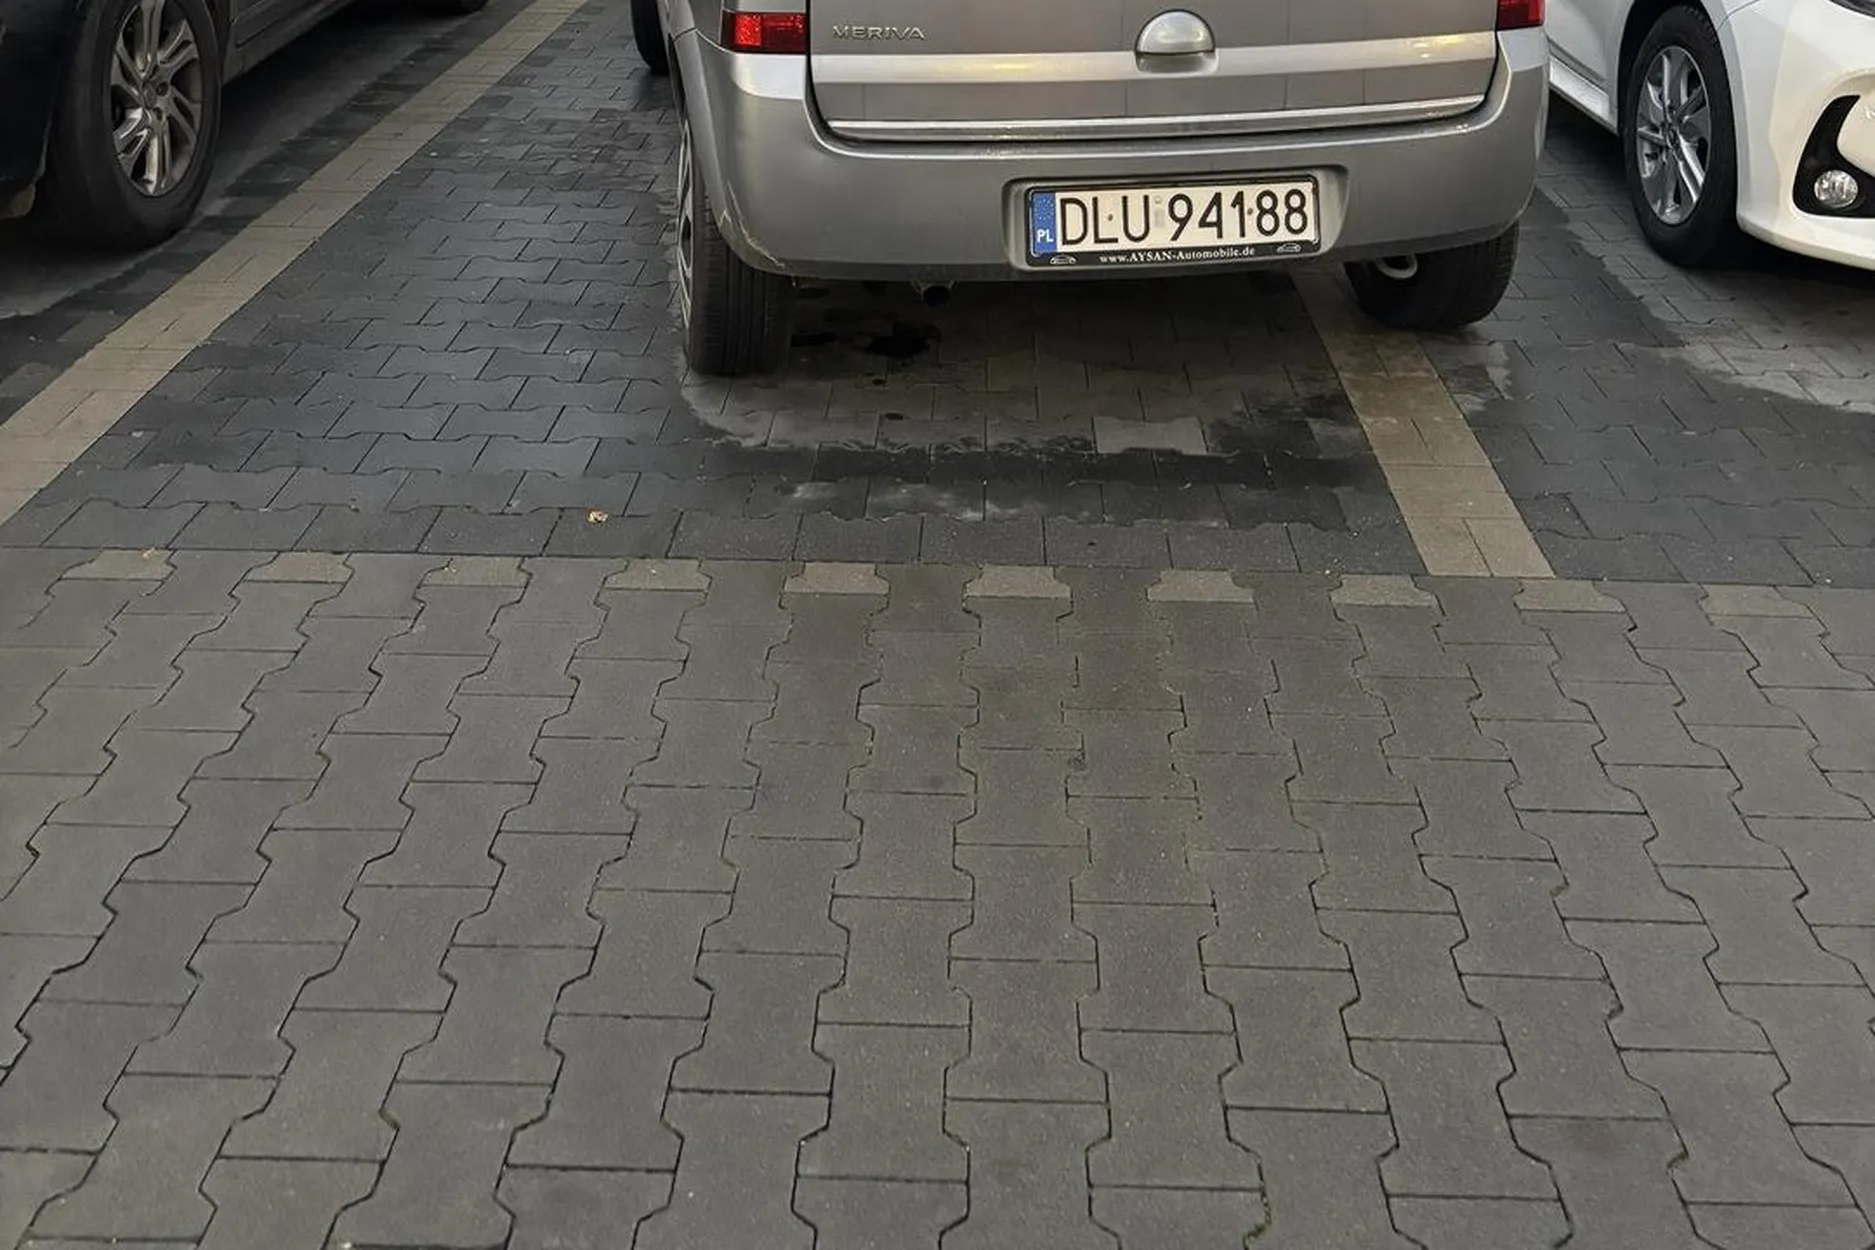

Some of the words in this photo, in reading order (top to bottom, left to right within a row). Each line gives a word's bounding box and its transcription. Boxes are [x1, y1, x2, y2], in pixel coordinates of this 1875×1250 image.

[833, 25, 926, 42] MERIVA
[1060, 194, 1150, 245] DLU
[1168, 188, 1308, 241] 94188
[1037, 228, 1054, 243] PL
[1099, 246, 1255, 264] www.AYSAN-Automobile.de
